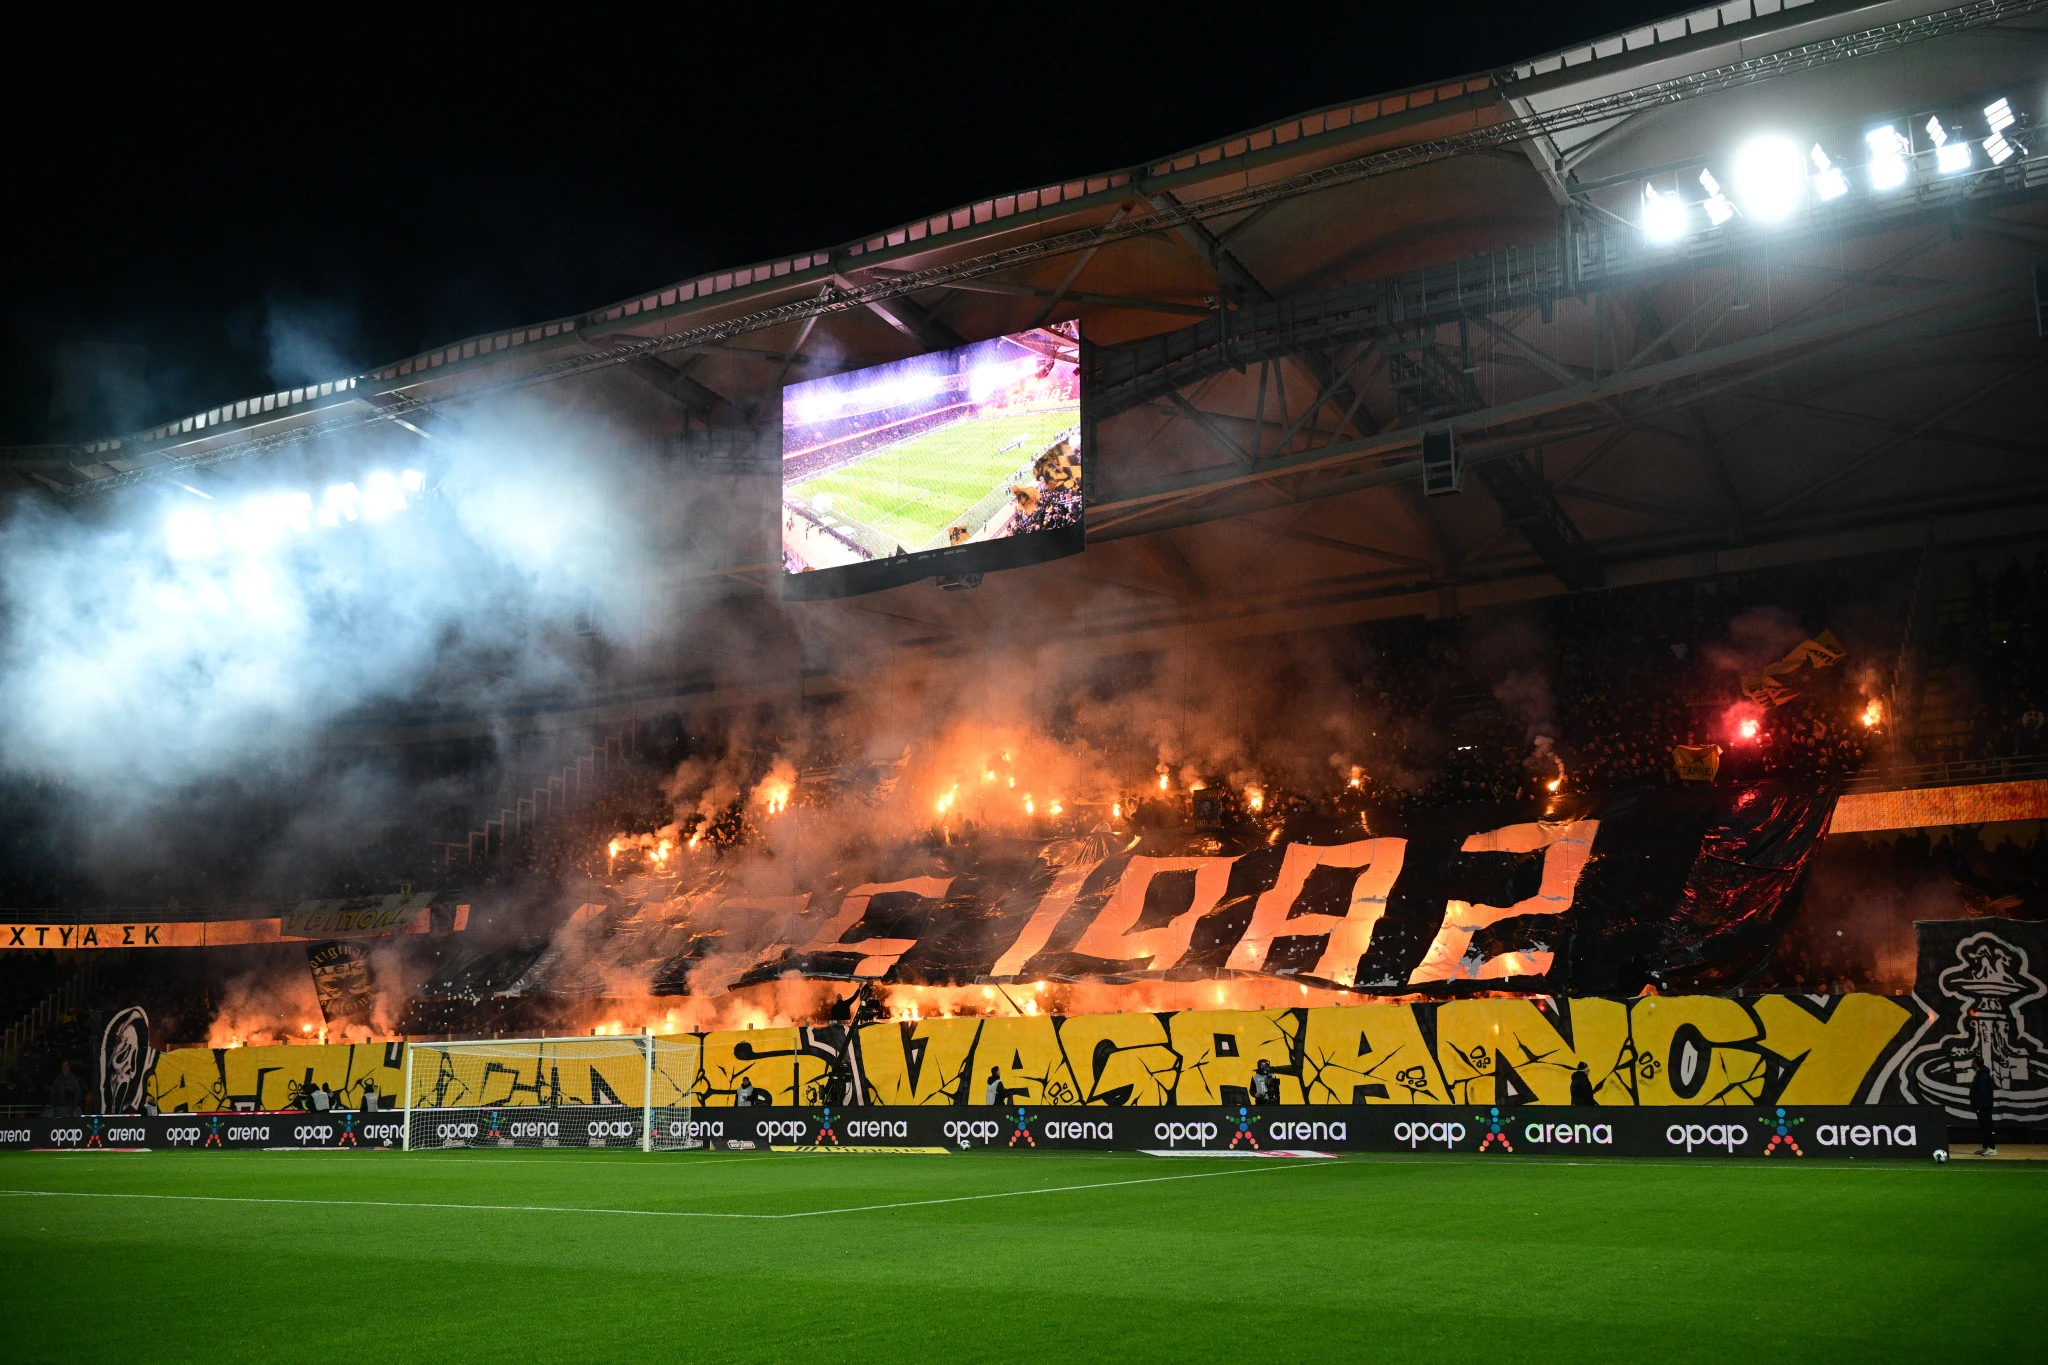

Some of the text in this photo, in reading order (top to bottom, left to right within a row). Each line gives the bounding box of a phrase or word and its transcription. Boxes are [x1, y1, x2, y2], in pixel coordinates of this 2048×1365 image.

[856, 992, 1910, 1108] VAGRANCY
[50, 1127, 146, 1147] opap arena
[166, 1126, 270, 1146] opap arena
[293, 1125, 333, 1145] opap
[437, 1121, 558, 1140] opap arena
[588, 1120, 724, 1139] opap arena
[756, 1120, 807, 1146] opap
[846, 1120, 908, 1138] arena
[943, 1120, 1113, 1150] opap arena
[1154, 1121, 1347, 1149] opap arena
[1393, 1122, 1613, 1150] opap arena
[1666, 1124, 1917, 1154] opap arena
